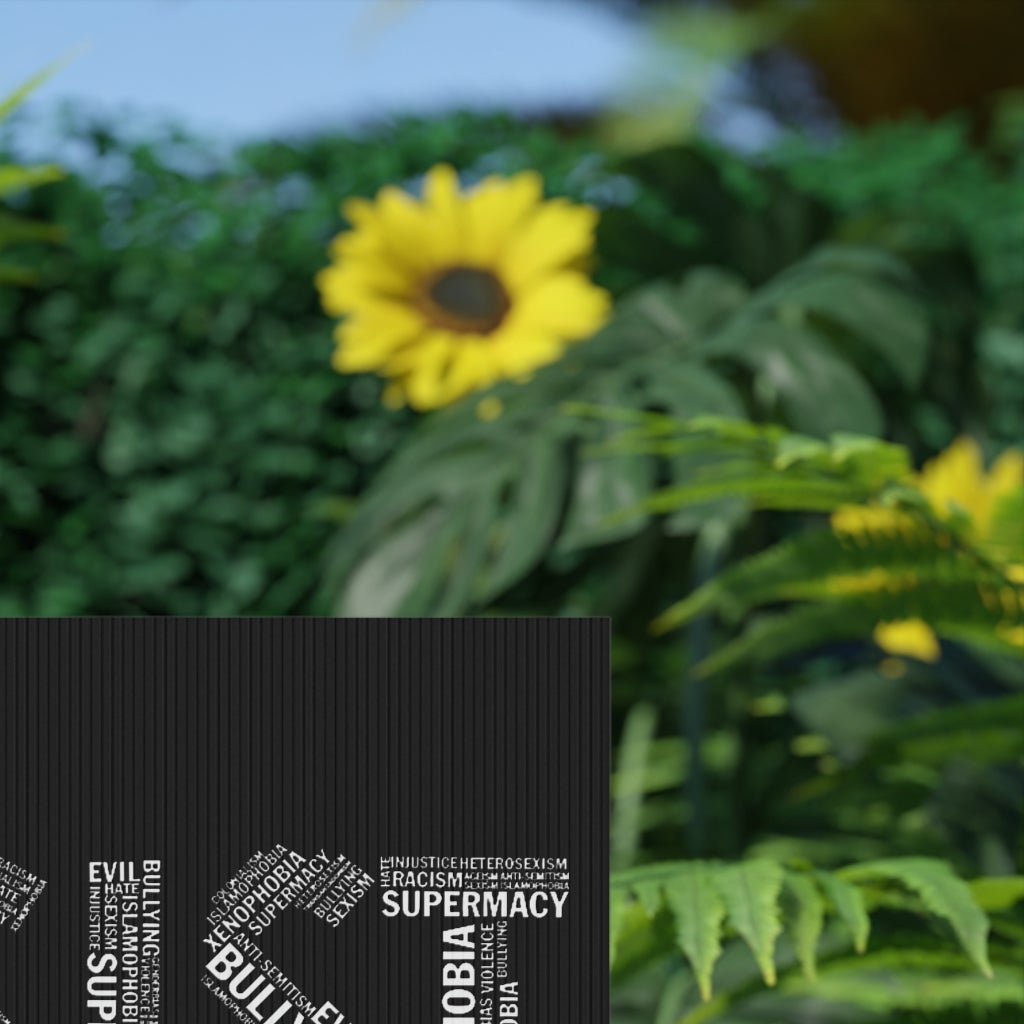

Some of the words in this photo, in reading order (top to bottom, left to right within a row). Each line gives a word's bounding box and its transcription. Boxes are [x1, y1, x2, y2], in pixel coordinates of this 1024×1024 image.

[89, 861, 141, 883] EVIL
[104, 883, 140, 895] HATE
[206, 843, 288, 926] ISLAMOPHOBIA
[380, 856, 391, 888] HATE
[390, 856, 458, 869] INJUSTICE
[392, 871, 464, 888] RACISM
[460, 857, 568, 870] HETEROSEXISM
[88, 886, 101, 951] INJUSTICE
[142, 859, 161, 957] BULLYING
[202, 850, 307, 953] XENOPHOBIA
[248, 848, 330, 936] SUPERMACY
[313, 864, 363, 919] BULLYING
[325, 872, 376, 928] SEXISM
[382, 890, 569, 918] SUPERMACY
[104, 894, 118, 950] SEXISM
[496, 920, 507, 978] BULLYING
[233, 932, 317, 1017] ANTI-SEMITISM
[480, 923, 494, 994] VIOLENCE
